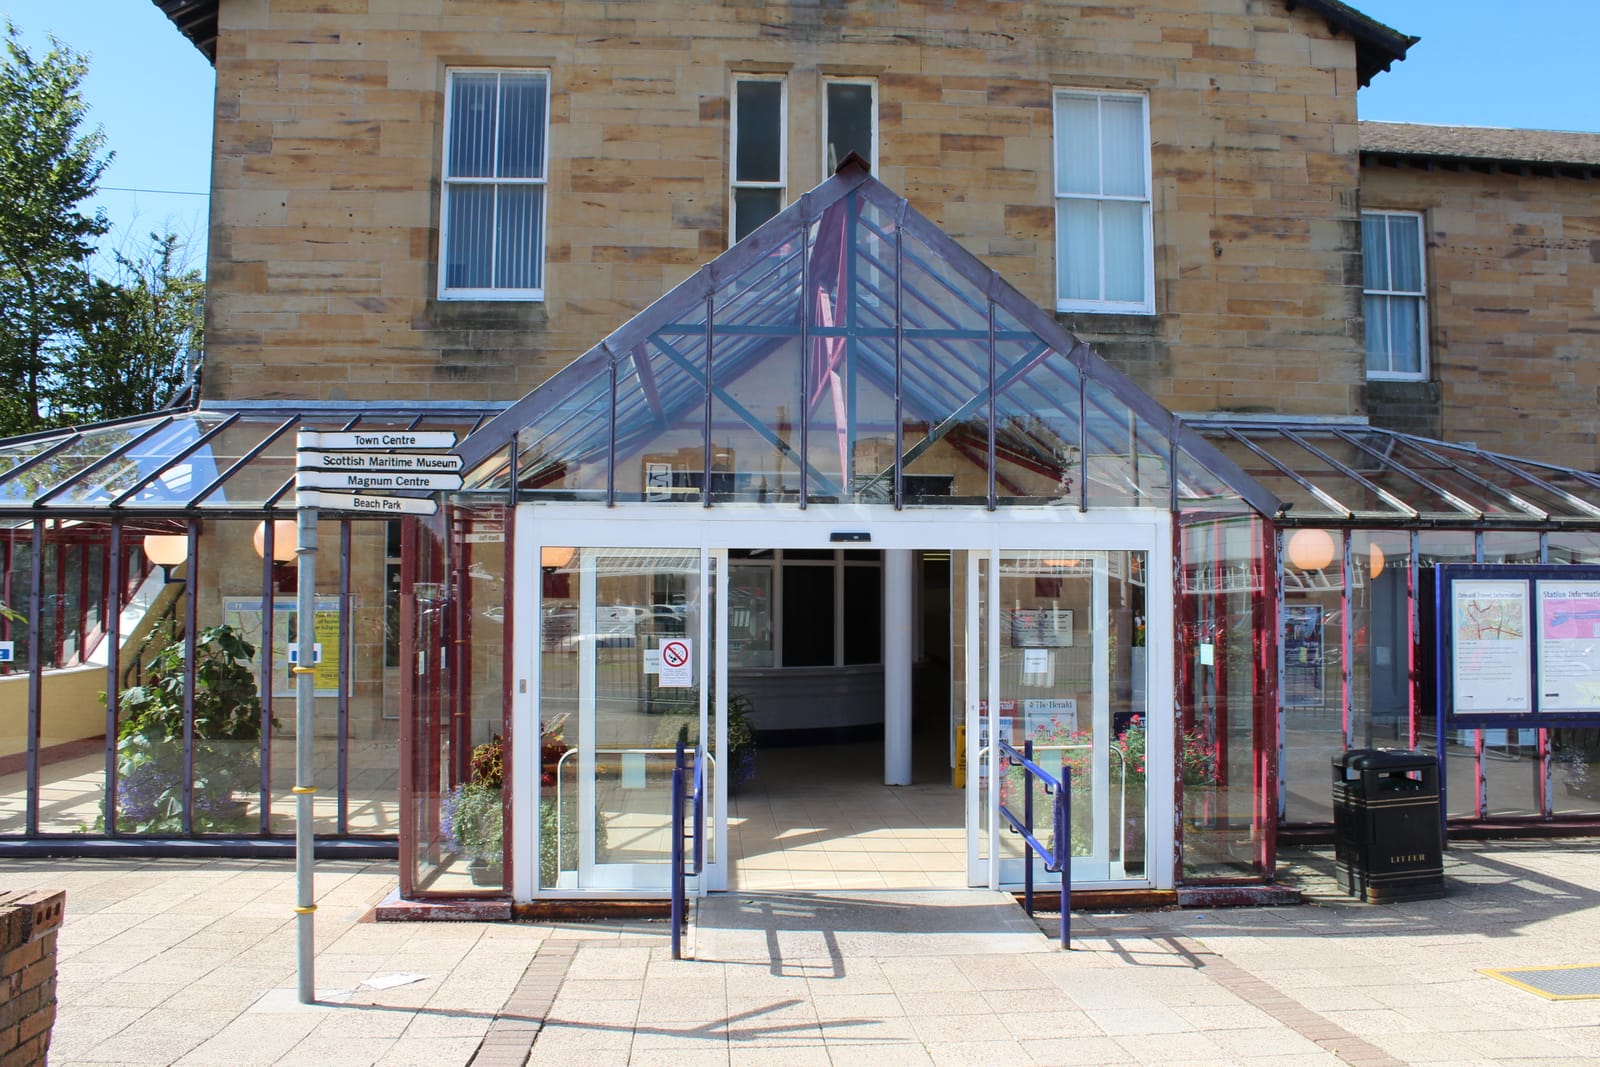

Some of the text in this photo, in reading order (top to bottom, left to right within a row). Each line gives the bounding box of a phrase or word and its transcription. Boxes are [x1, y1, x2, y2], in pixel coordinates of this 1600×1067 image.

[354, 435, 416, 445] Town Centre
[323, 455, 458, 468] Scottish Maritime Museum
[348, 475, 430, 487] Magnum Centre
[353, 498, 402, 510] Beach Park
[1049, 701, 1073, 709] Herald
[1390, 853, 1425, 864] LITTER
